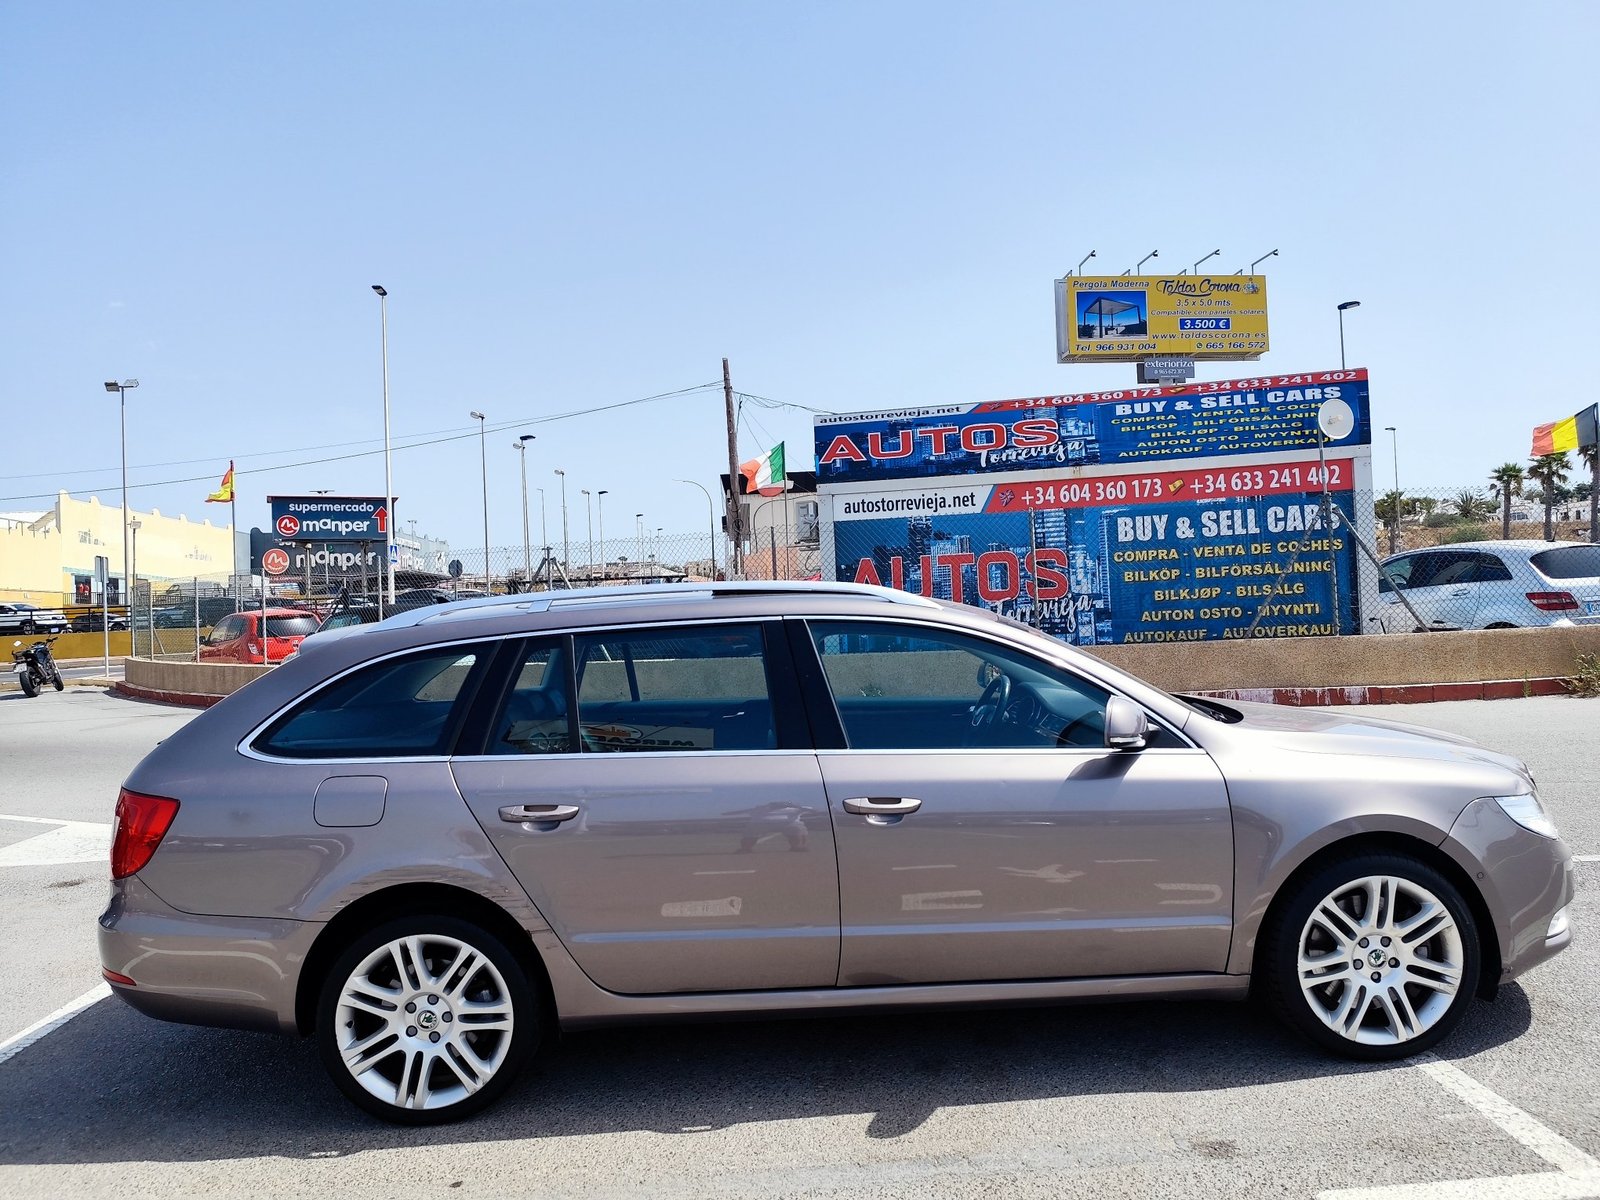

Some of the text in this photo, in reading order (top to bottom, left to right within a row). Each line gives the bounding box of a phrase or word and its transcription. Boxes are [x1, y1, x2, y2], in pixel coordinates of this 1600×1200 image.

[1073, 280, 1150, 290] Pergola Moderna
[1156, 278, 1241, 296] Toldos Corona
[1183, 319, 1227, 329] 3.500 €
[1152, 332, 1266, 340] www.toldoscorona.es
[1145, 359, 1194, 368] exterioriza
[1192, 371, 1357, 392] +34 633 241 402
[1010, 388, 1162, 408] +34 604 360 173
[1115, 386, 1342, 416] BUY & SELL CARS
[820, 405, 962, 424] autostorrevieja.net
[1111, 414, 1177, 424] COMPRA
[1192, 408, 1244, 418] VENTA
[1250, 406, 1271, 414] DE
[1276, 403, 1323, 411] COCH
[1137, 439, 1191, 448] AUTON
[1196, 435, 1239, 443] OSTO
[1254, 429, 1318, 439] MYYNTI
[1150, 428, 1218, 438] BILKJØP
[1234, 422, 1302, 432] BILSALG
[819, 418, 1059, 464] AUTOS
[978, 440, 1083, 468] Torrevieja
[1118, 446, 1203, 457] AUTOKAUF
[1190, 473, 1226, 494] +34
[1230, 470, 1264, 491] 633
[1269, 468, 1301, 488] 241
[1021, 478, 1163, 505] +34 604 360 173
[288, 502, 374, 514] supermercado
[843, 491, 976, 514] autostorrevieja.net
[302, 518, 370, 536] manper
[1117, 514, 1169, 542] BUY
[1175, 516, 1195, 539] &
[1201, 508, 1260, 537] SELL
[1113, 548, 1179, 562] COMPRA
[1192, 544, 1246, 558] VENTA
[1250, 542, 1272, 555] DE
[1276, 538, 1344, 553] COCHES
[1124, 568, 1181, 582] BILKÖP
[1154, 586, 1221, 601] BILKJØP
[1236, 582, 1305, 597] BILSALG
[1141, 608, 1194, 622] AUTON
[1200, 607, 1242, 619] OSTO
[1124, 629, 1208, 643] AUTOKAUF
